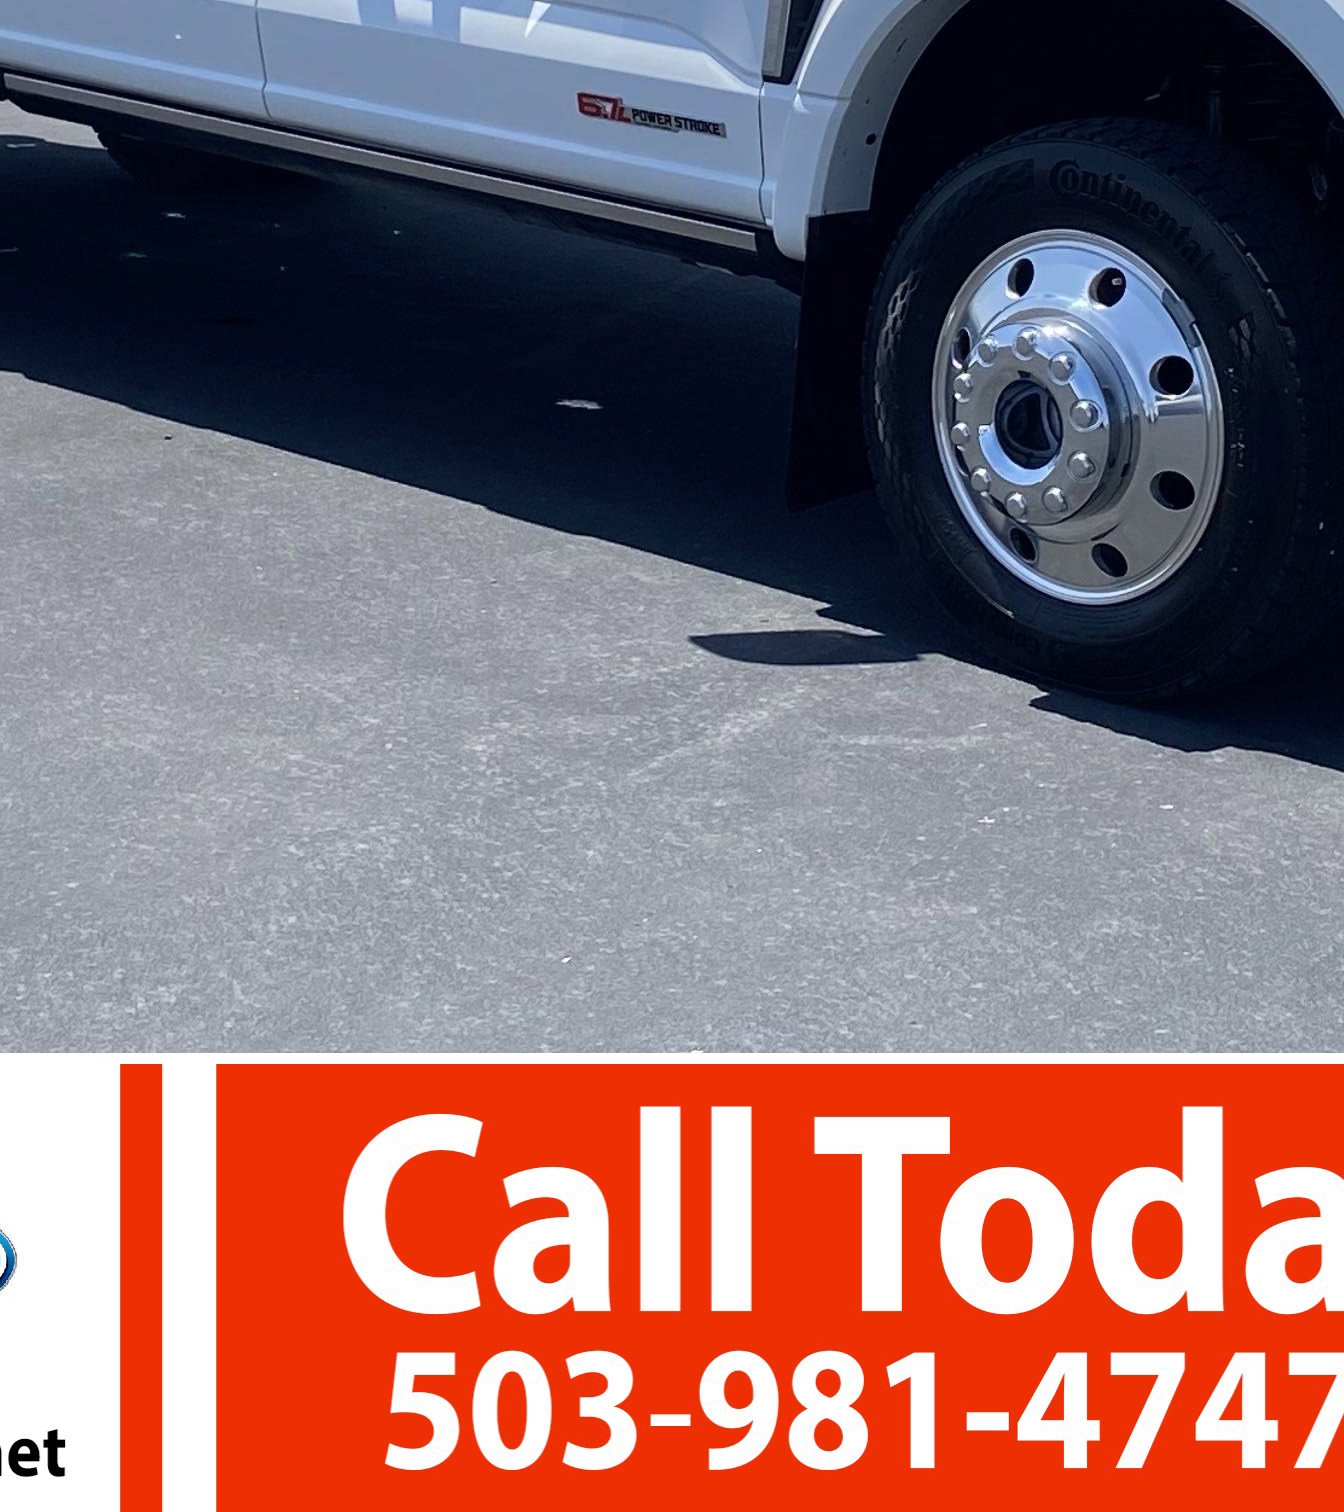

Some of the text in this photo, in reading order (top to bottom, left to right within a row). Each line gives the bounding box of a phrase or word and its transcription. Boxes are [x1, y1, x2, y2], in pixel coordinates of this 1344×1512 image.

[631, 107, 673, 128] POWER
[674, 114, 722, 137] STROKE
[1049, 159, 1217, 274] Continental
